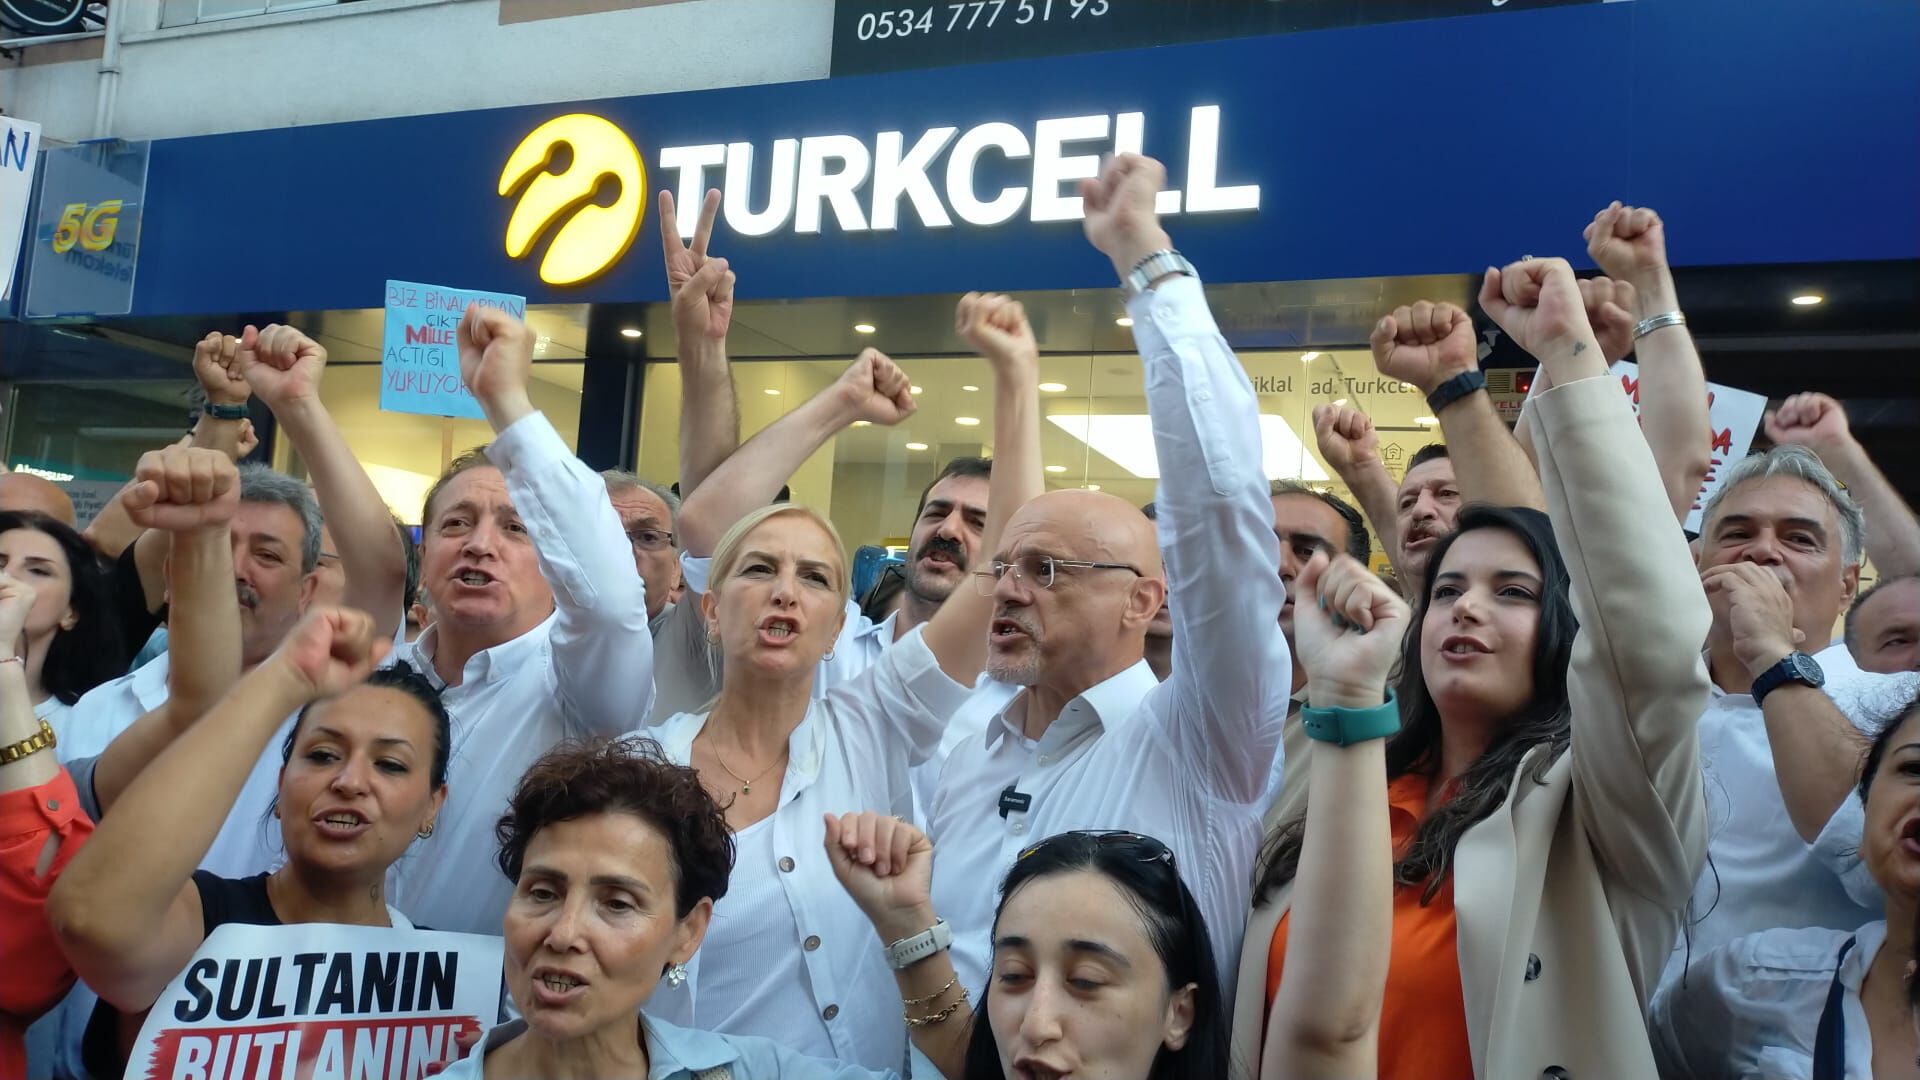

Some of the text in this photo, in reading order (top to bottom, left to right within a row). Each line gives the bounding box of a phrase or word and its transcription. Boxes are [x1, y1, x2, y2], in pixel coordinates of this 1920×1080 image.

[857, 6, 933, 40] 0534
[947, 0, 1003, 32] 777
[1015, 0, 1052, 24] 51
[0, 127, 32, 171] N
[659, 104, 1261, 239] TURKCELL
[52, 200, 123, 253] 5G
[1251, 376, 1293, 393] iklal
[1344, 377, 1417, 394] Turkce
[174, 952, 459, 1023] SULTANIN
